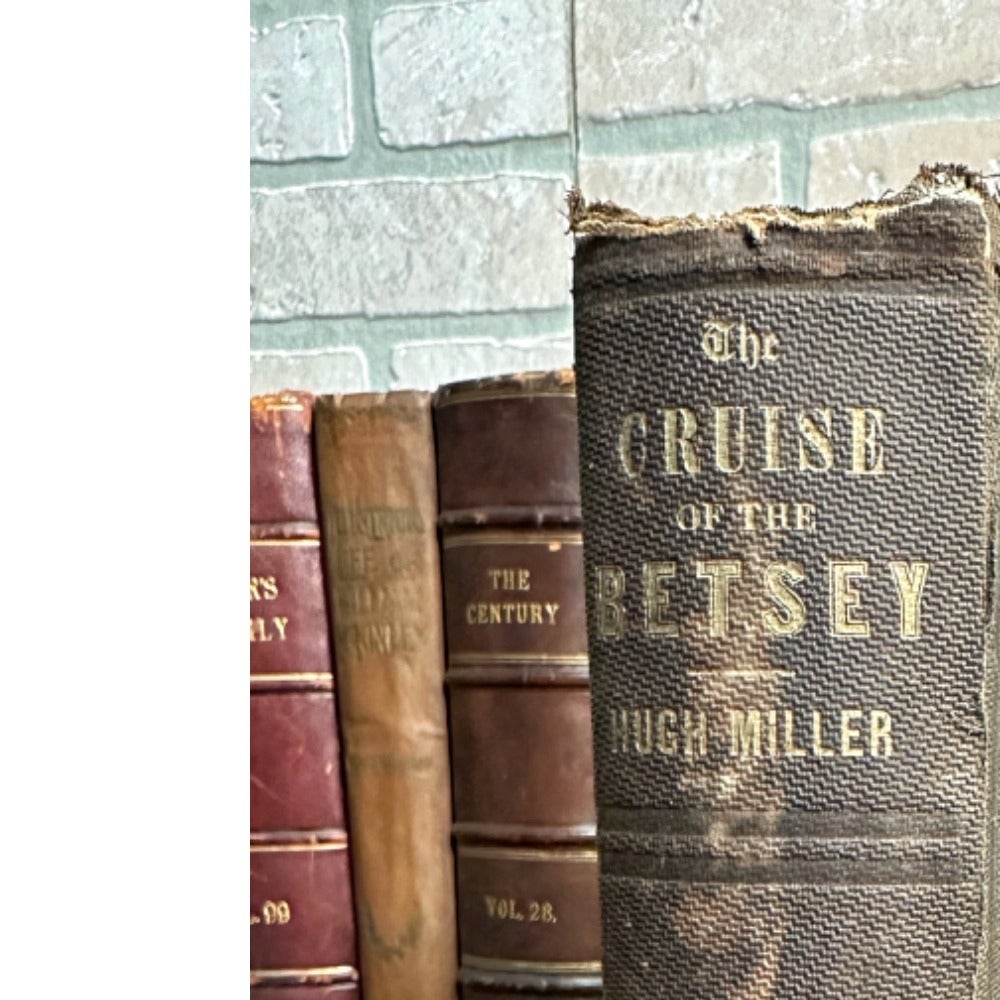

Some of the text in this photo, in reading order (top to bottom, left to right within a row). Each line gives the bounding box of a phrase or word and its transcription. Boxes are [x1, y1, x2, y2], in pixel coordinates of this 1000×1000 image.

[701, 320, 780, 370] The
[618, 405, 886, 477] CRUISE
[676, 502, 817, 532] OF THE
[488, 568, 531, 591] THE
[595, 559, 930, 640] BETSEY
[465, 602, 560, 627] CENTURY
[610, 708, 894, 758] HUGH MILLER
